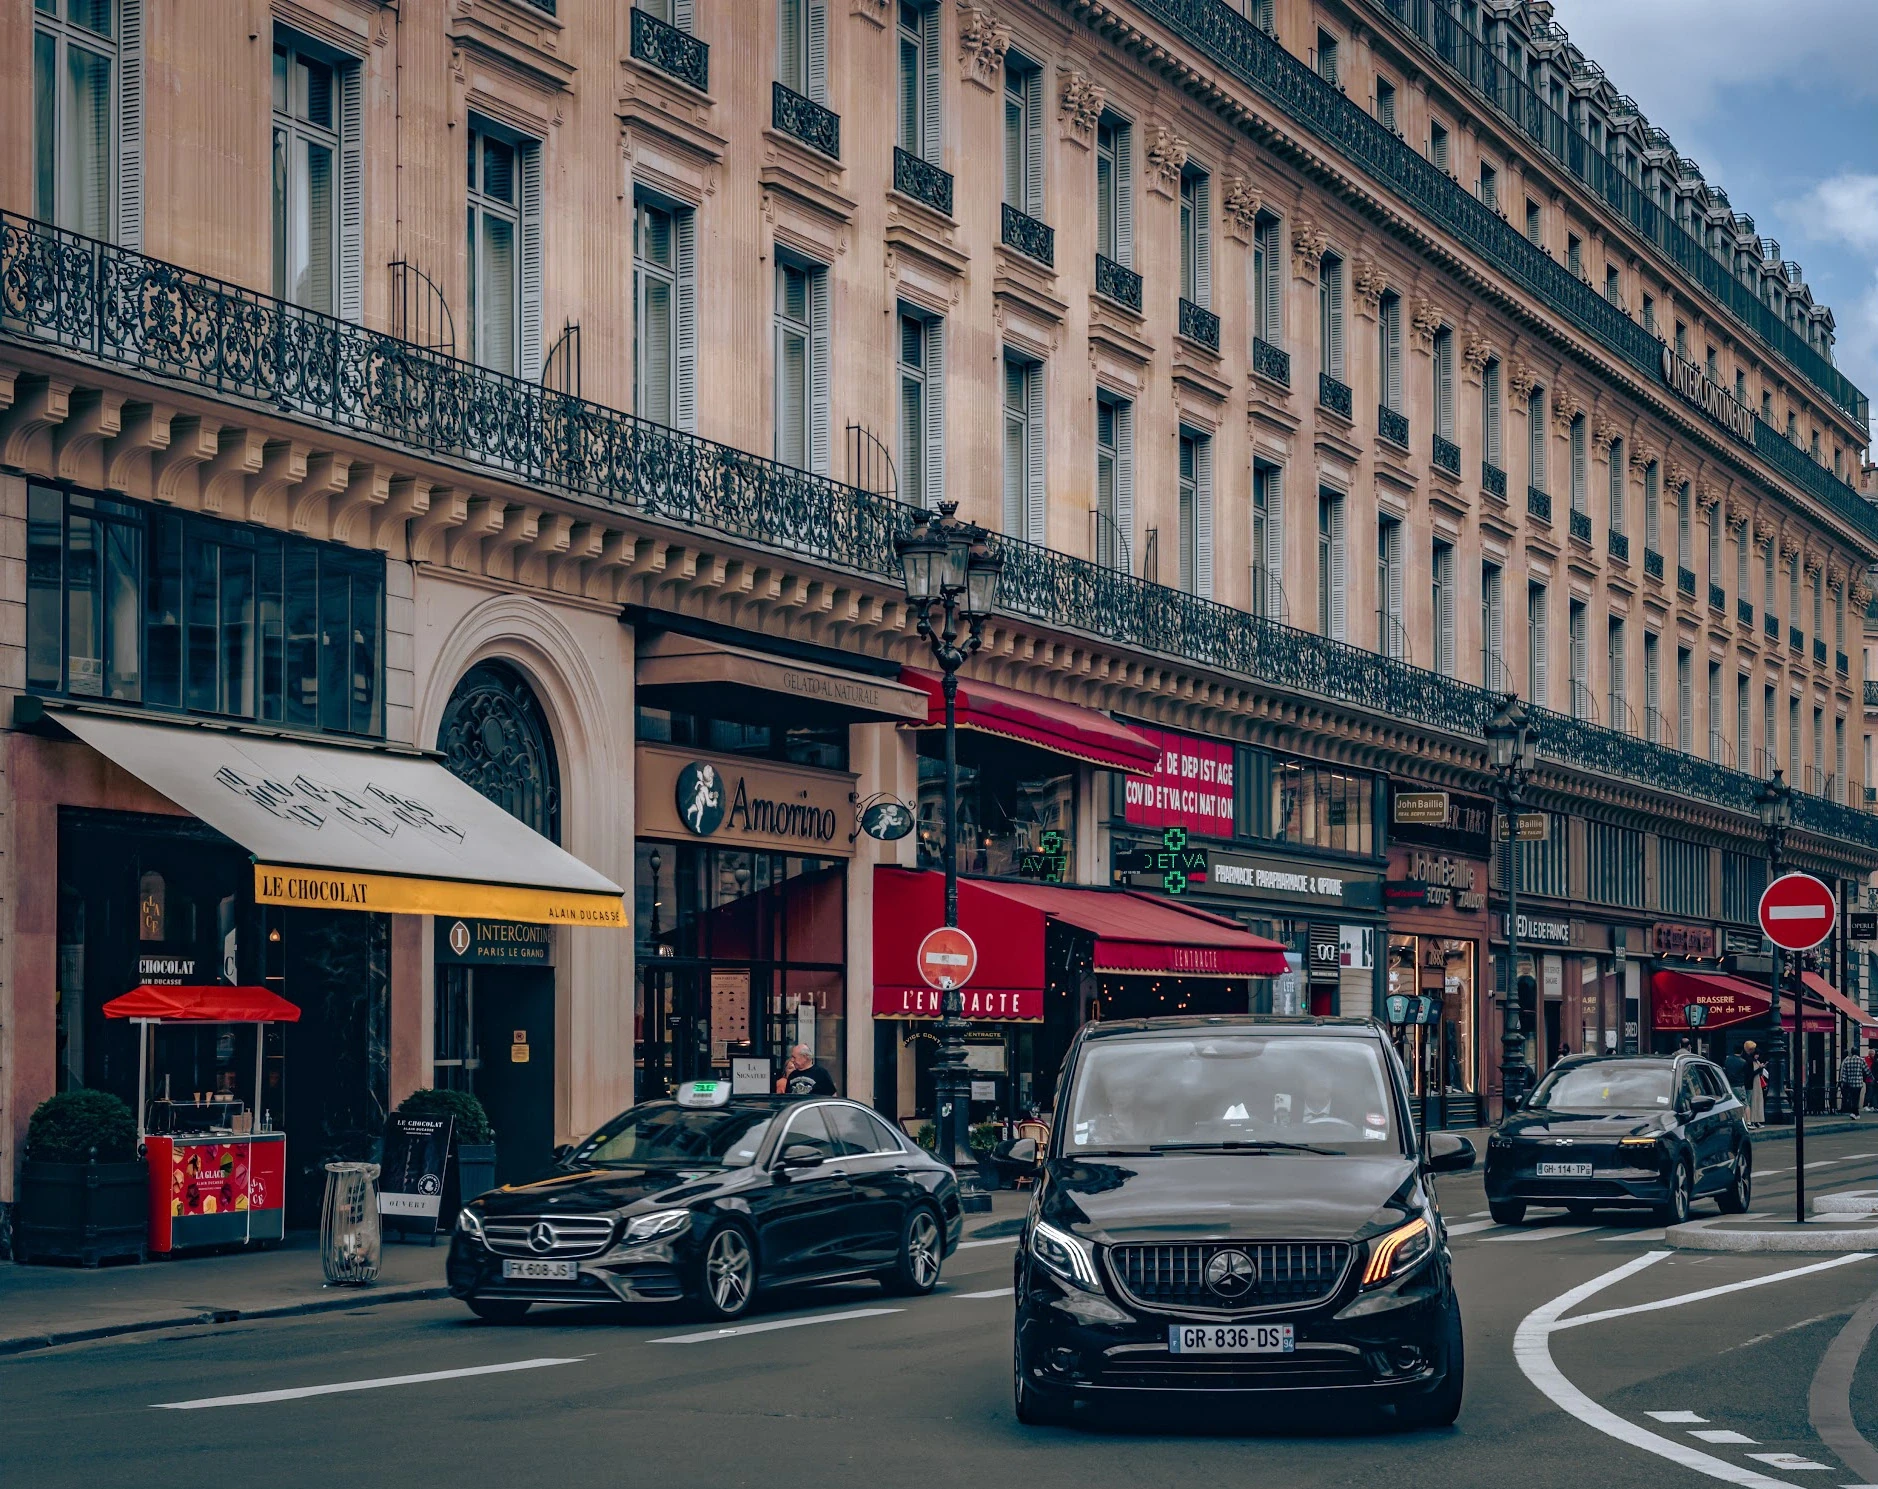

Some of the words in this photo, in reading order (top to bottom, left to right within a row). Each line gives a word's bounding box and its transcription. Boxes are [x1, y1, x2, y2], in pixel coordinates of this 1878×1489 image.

[1673, 349, 1756, 446] INTERCONTINENTAL
[783, 672, 820, 693] GELATO
[822, 681, 833, 696] AL
[834, 684, 879, 705] NATURALE
[1167, 751, 1178, 775] DE
[1126, 780, 1154, 807] COVID
[726, 777, 836, 841] Amorino
[1397, 800, 1417, 809] John
[1418, 799, 1444, 809] Baillie
[1520, 820, 1543, 828] Baillie
[1412, 852, 1440, 885] John
[1440, 856, 1475, 890] Baillie
[263, 876, 283, 897] LE
[288, 878, 368, 904] CHOCOLAT
[549, 907, 576, 919] ALAIN
[580, 909, 621, 922] DUCASSE
[1528, 920, 1538, 938] ILE
[1538, 922, 1546, 939] DE
[1546, 923, 1569, 941] FRANCE
[477, 947, 505, 957] PARIS
[508, 947, 518, 957] LE
[521, 948, 544, 958] GRAND
[1174, 949, 1217, 968] L'ENTRACTE
[139, 959, 195, 974] CHOCOLAT
[1696, 995, 1735, 1004] BRASSERIE
[1725, 1005, 1735, 1013] de
[748, 1063, 756, 1071] LA
[408, 1120, 443, 1128] CHOCOLAT
[196, 1171, 204, 1180] LA
[204, 1170, 226, 1179] GLACE
[1544, 1164, 1586, 1174] GH-114-TP
[389, 1200, 425, 1208] OUVERT
[1184, 1328, 1280, 1348] GR-836-DS
[1283, 1338, 1294, 1349] 94
